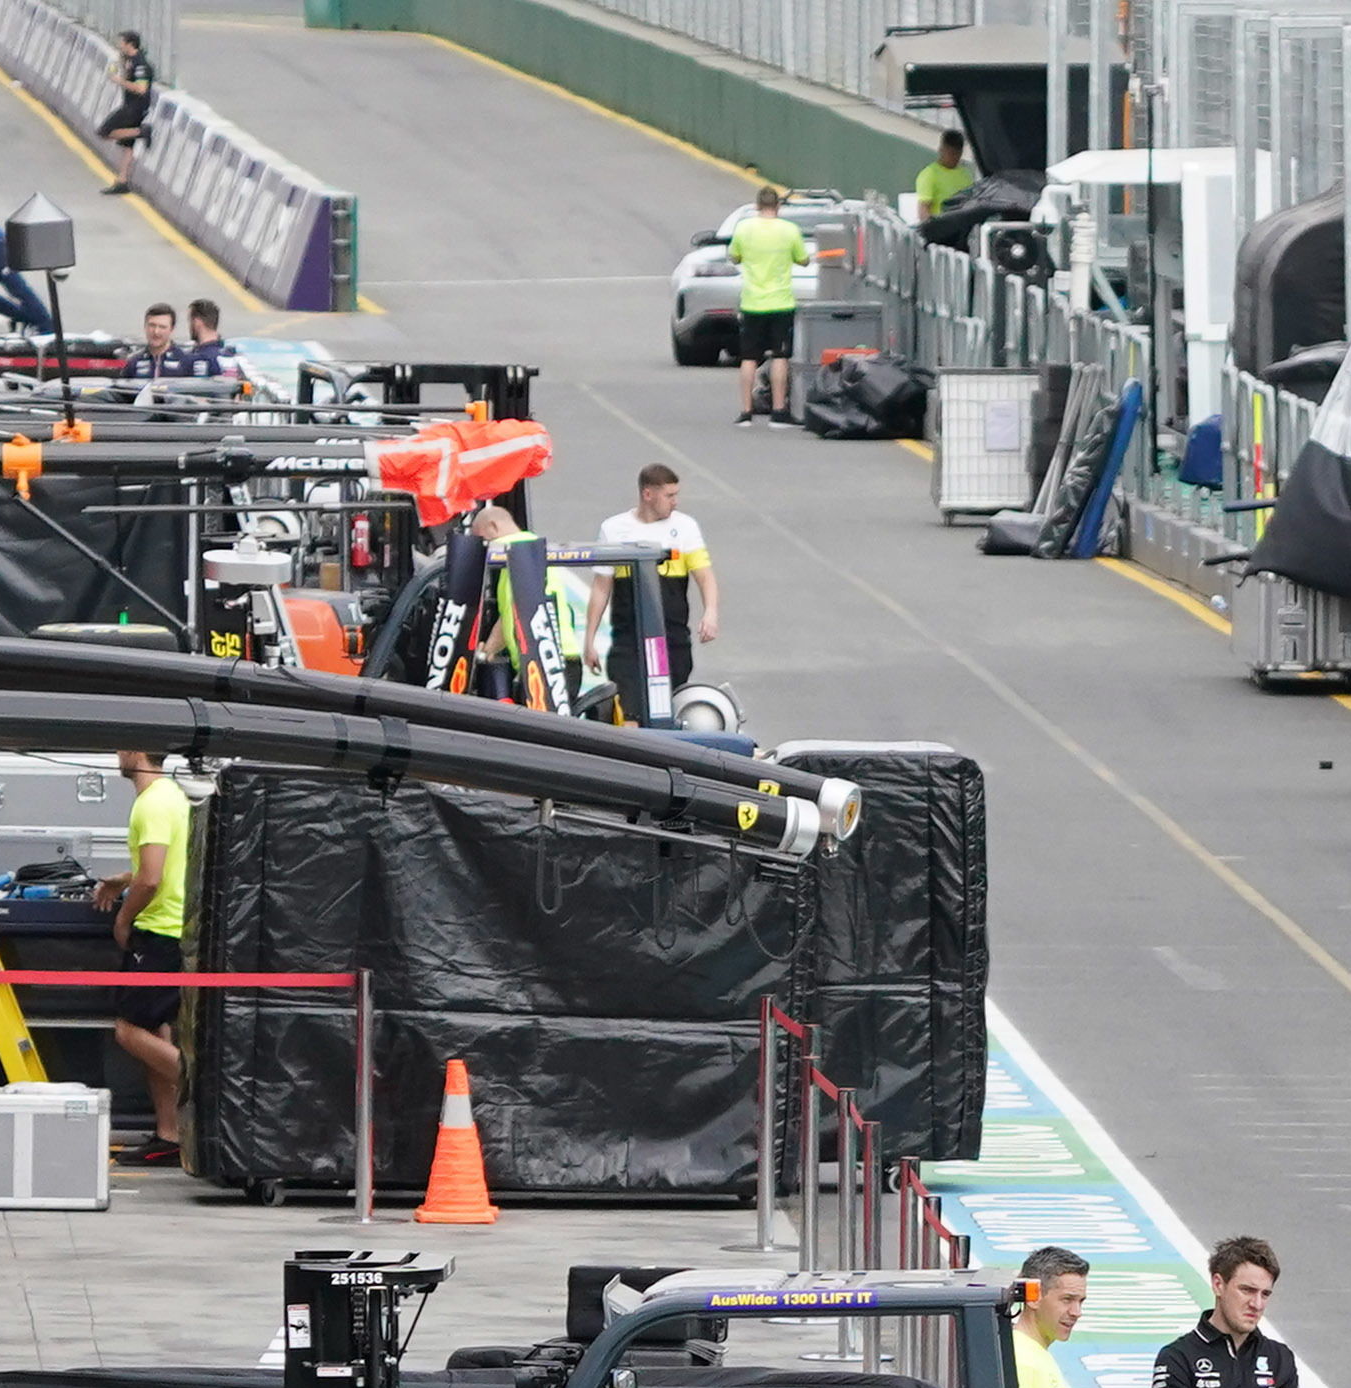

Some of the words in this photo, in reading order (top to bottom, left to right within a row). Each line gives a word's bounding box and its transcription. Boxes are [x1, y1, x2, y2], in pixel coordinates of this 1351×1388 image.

[265, 456, 365, 470] McLare
[425, 599, 468, 691] HON
[529, 603, 572, 717] ONDA
[331, 1272, 383, 1285] 251536
[711, 1294, 777, 1306] AusWide:
[782, 1293, 818, 1305] 1300
[821, 1292, 853, 1304] LIFT
[857, 1292, 872, 1304] IT
